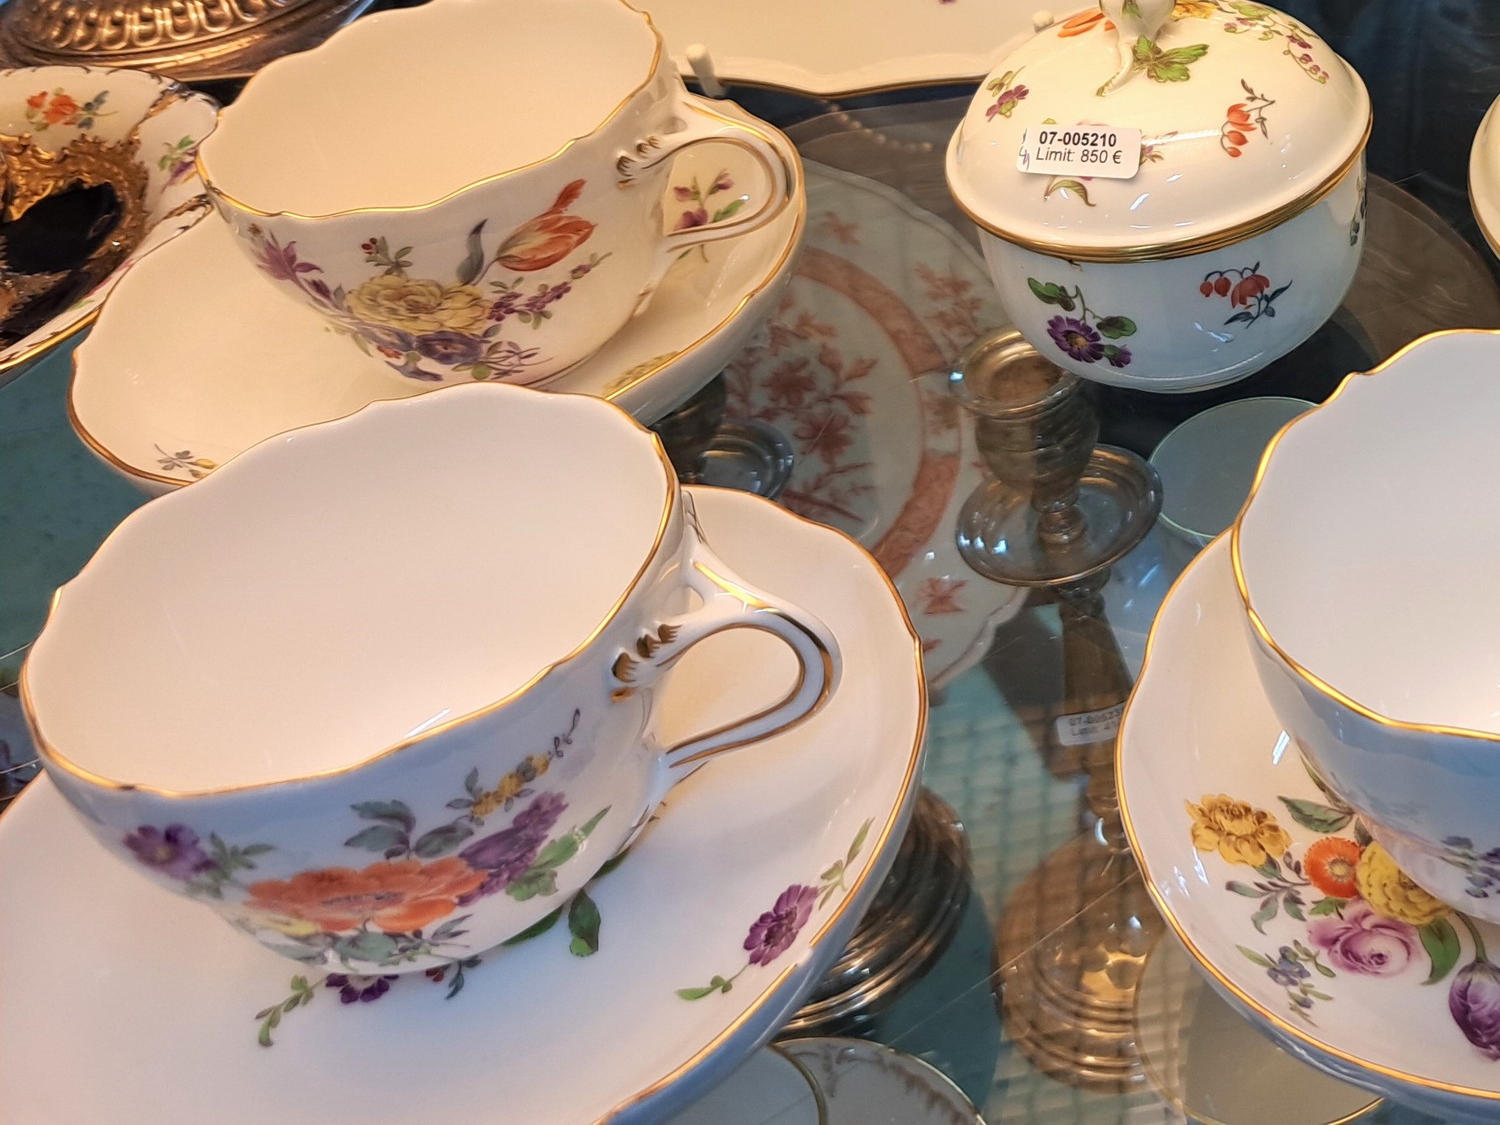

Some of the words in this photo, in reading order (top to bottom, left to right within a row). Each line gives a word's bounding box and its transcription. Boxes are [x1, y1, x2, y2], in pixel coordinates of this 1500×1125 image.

[1039, 131, 1117, 147] 07-005210
[1080, 149, 1108, 164] 850
[1112, 150, 1123, 164] €
